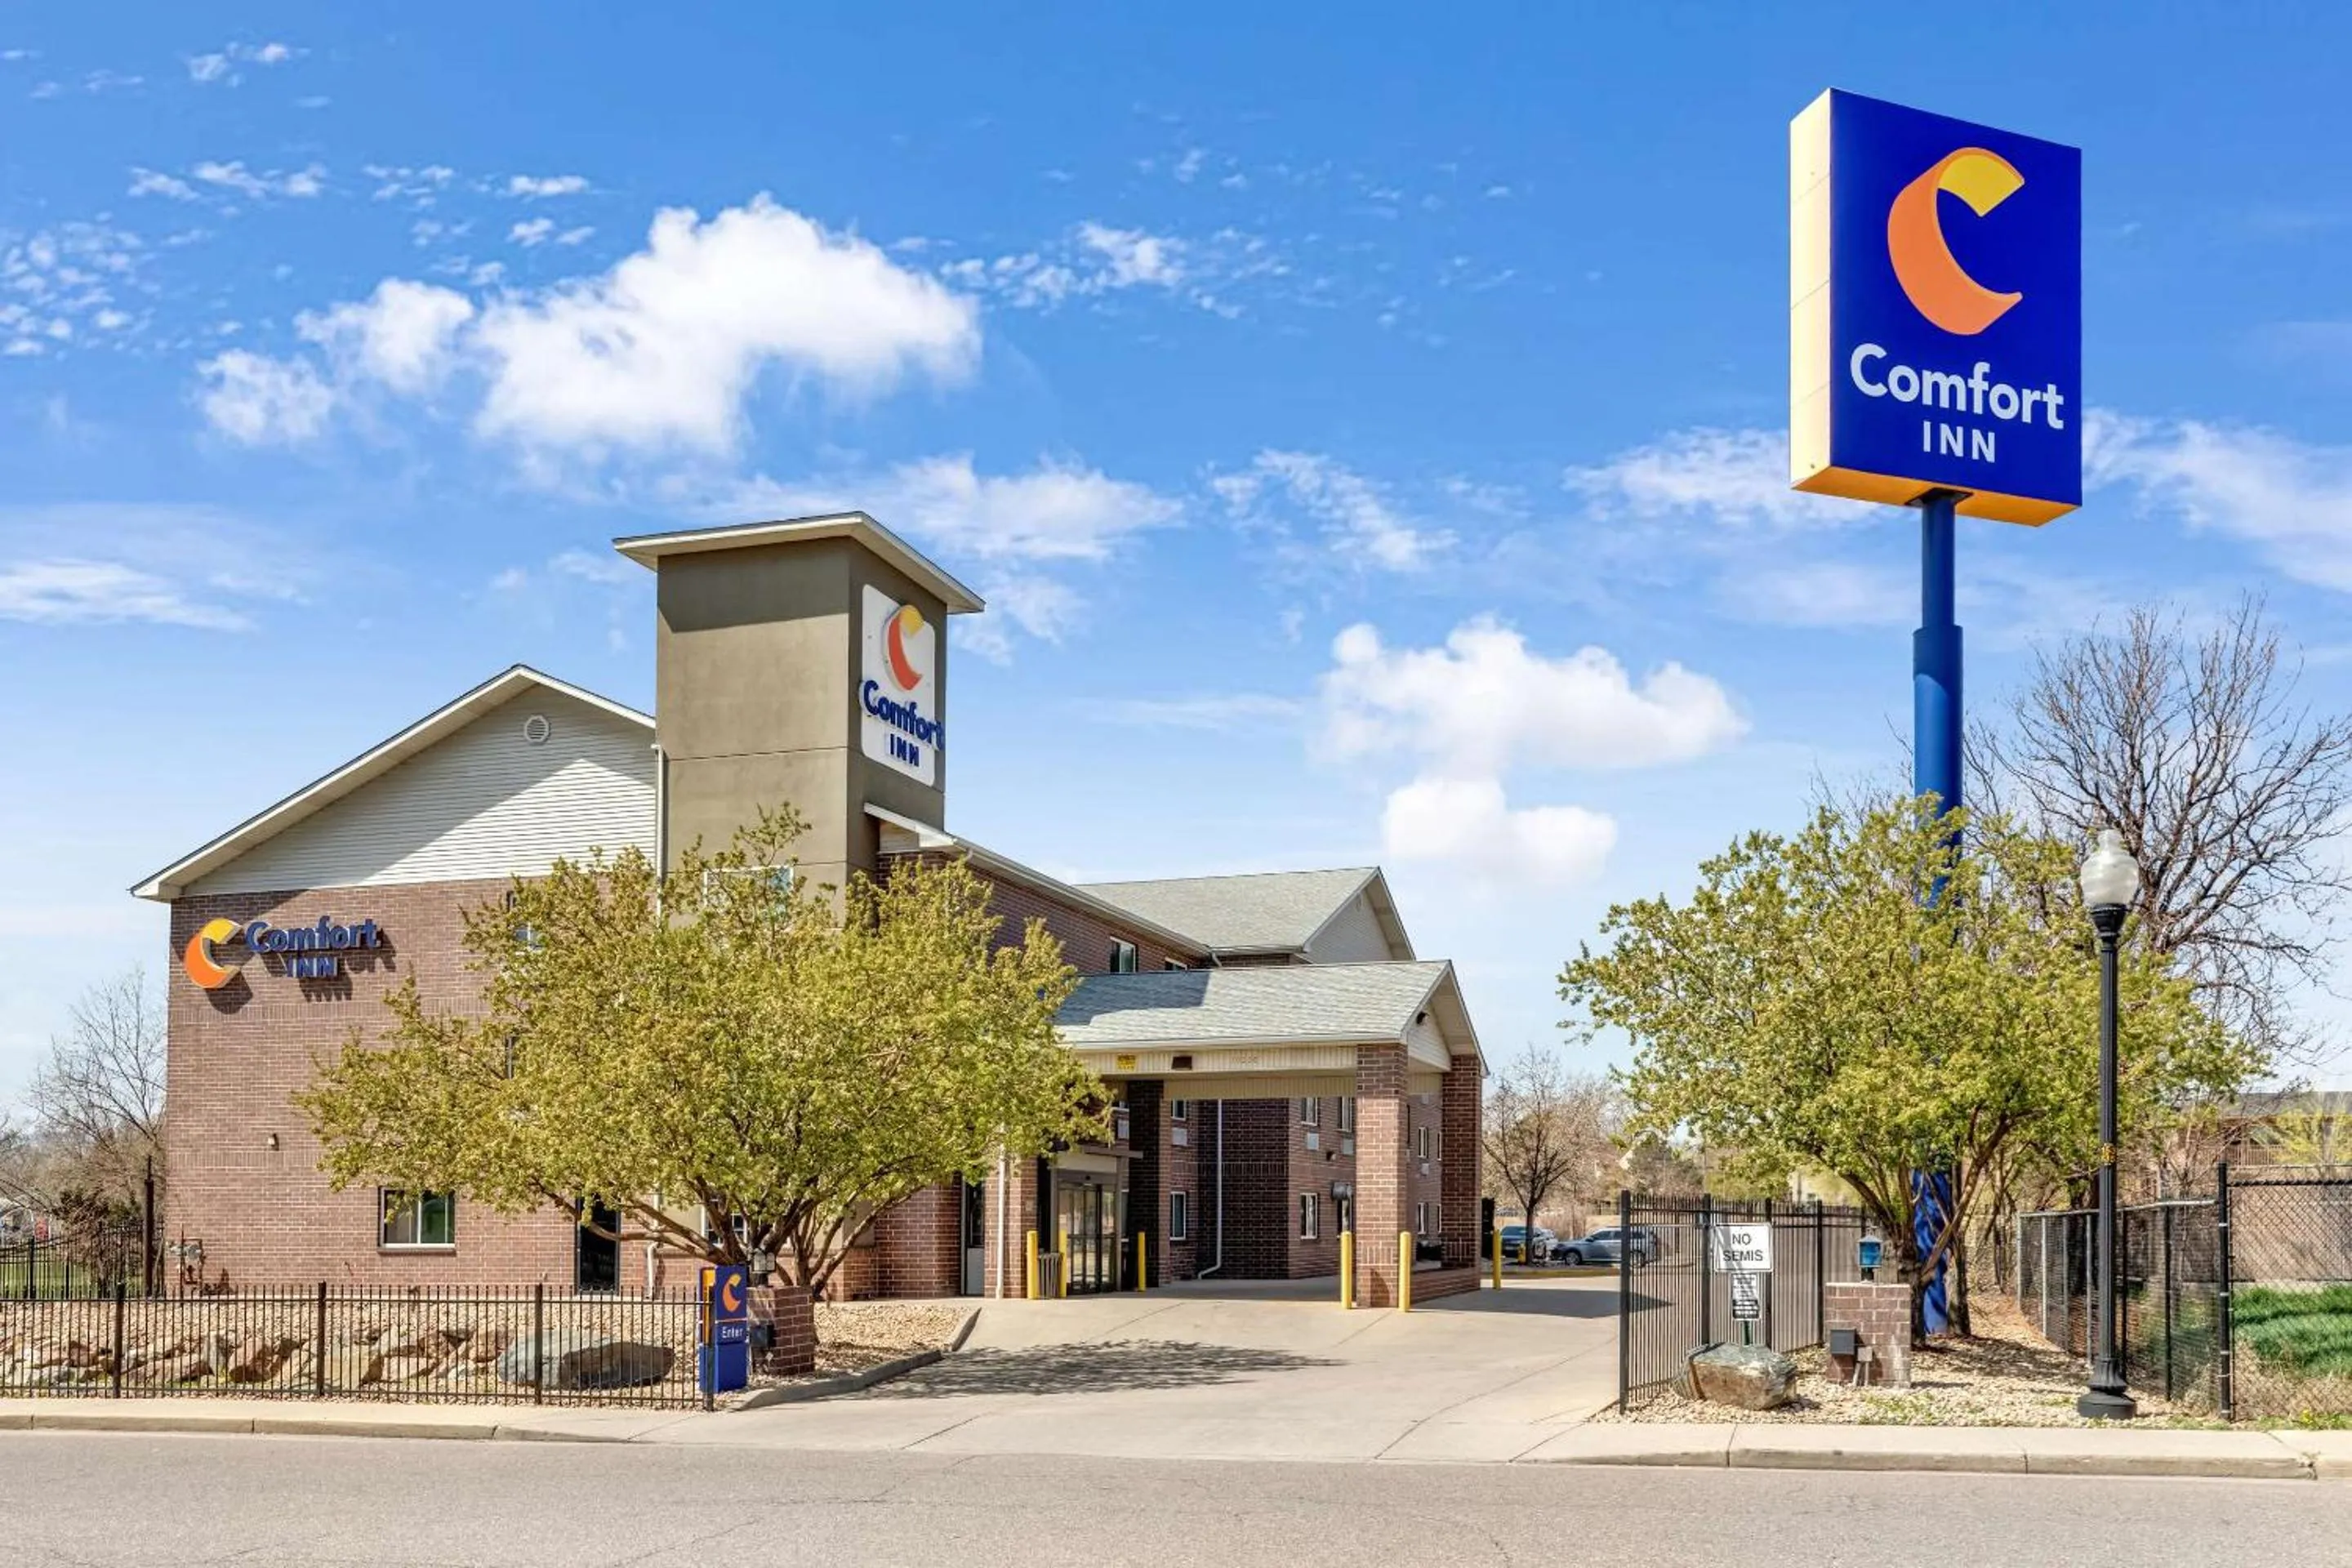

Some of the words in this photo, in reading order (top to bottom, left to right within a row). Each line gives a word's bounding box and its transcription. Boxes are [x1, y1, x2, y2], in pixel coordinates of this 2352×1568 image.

[1850, 343, 2065, 430] Comfort
[1922, 421, 1996, 464] INN
[863, 679, 945, 751] Comfort
[889, 733, 920, 768] INN
[245, 915, 379, 953] Comfort
[286, 956, 337, 978] INN
[1722, 1249, 1764, 1262] SEMIS
[1731, 1232, 1753, 1245] NO
[721, 1325, 744, 1339] Enter
